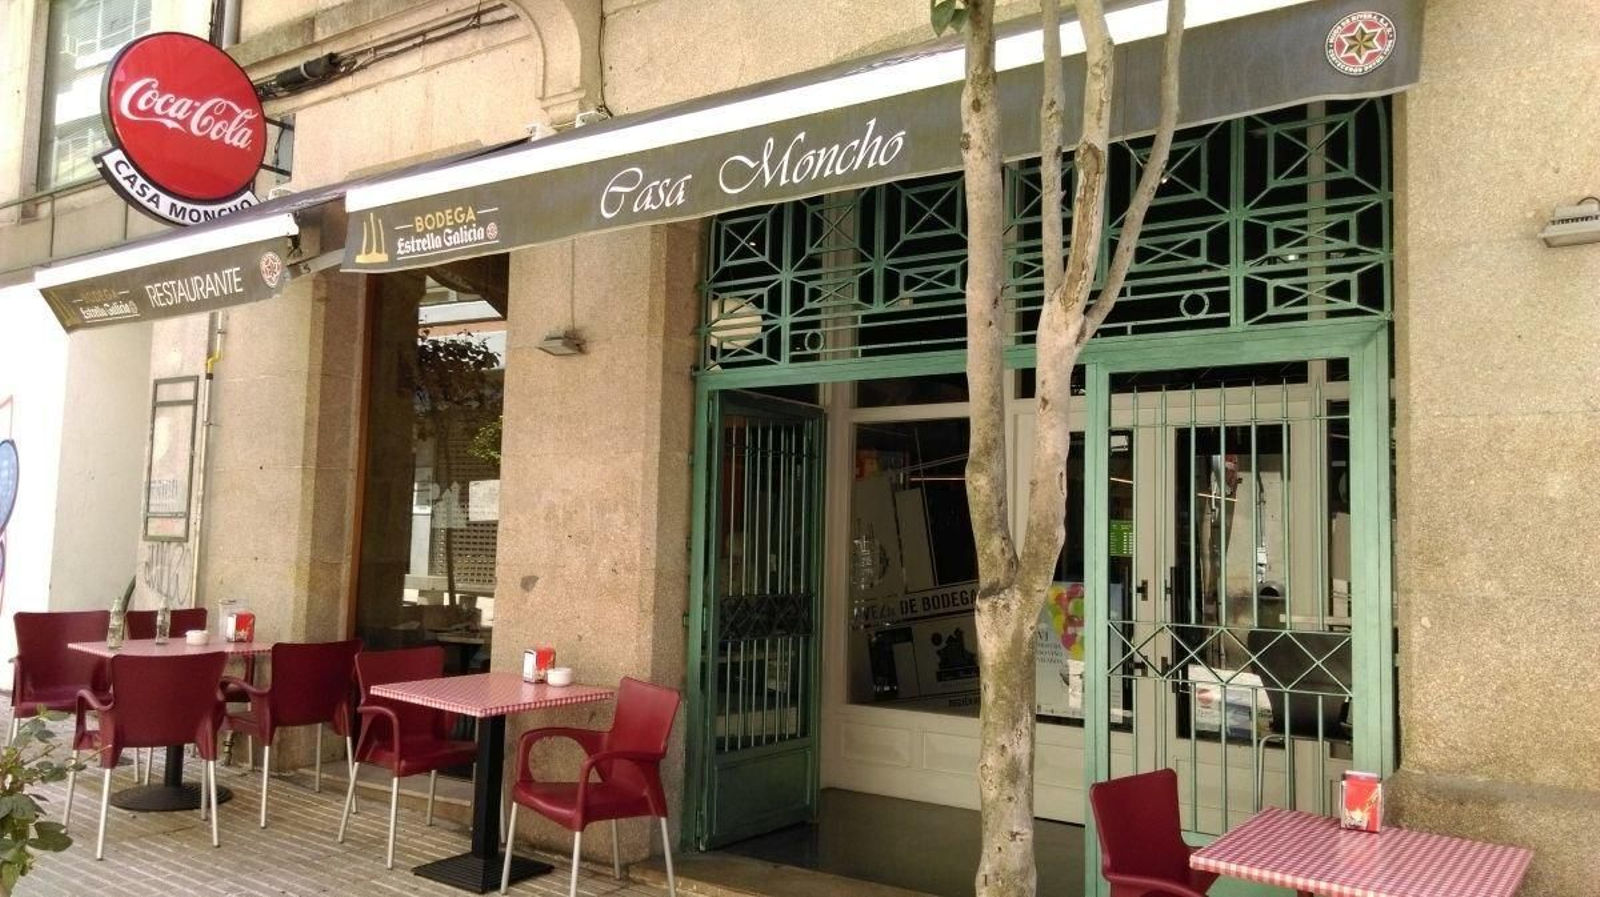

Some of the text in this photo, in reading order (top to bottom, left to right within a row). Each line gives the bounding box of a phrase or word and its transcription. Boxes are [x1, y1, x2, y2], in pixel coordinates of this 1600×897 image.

[120, 77, 258, 150] Coca-Cola
[114, 159, 162, 209] CASA
[600, 117, 906, 220] Casa Moncho
[396, 223, 485, 255] Estrella Galicia
[415, 206, 476, 232] BODEGA
[145, 267, 243, 308] RESTAURANTE
[900, 600, 918, 615] DE
